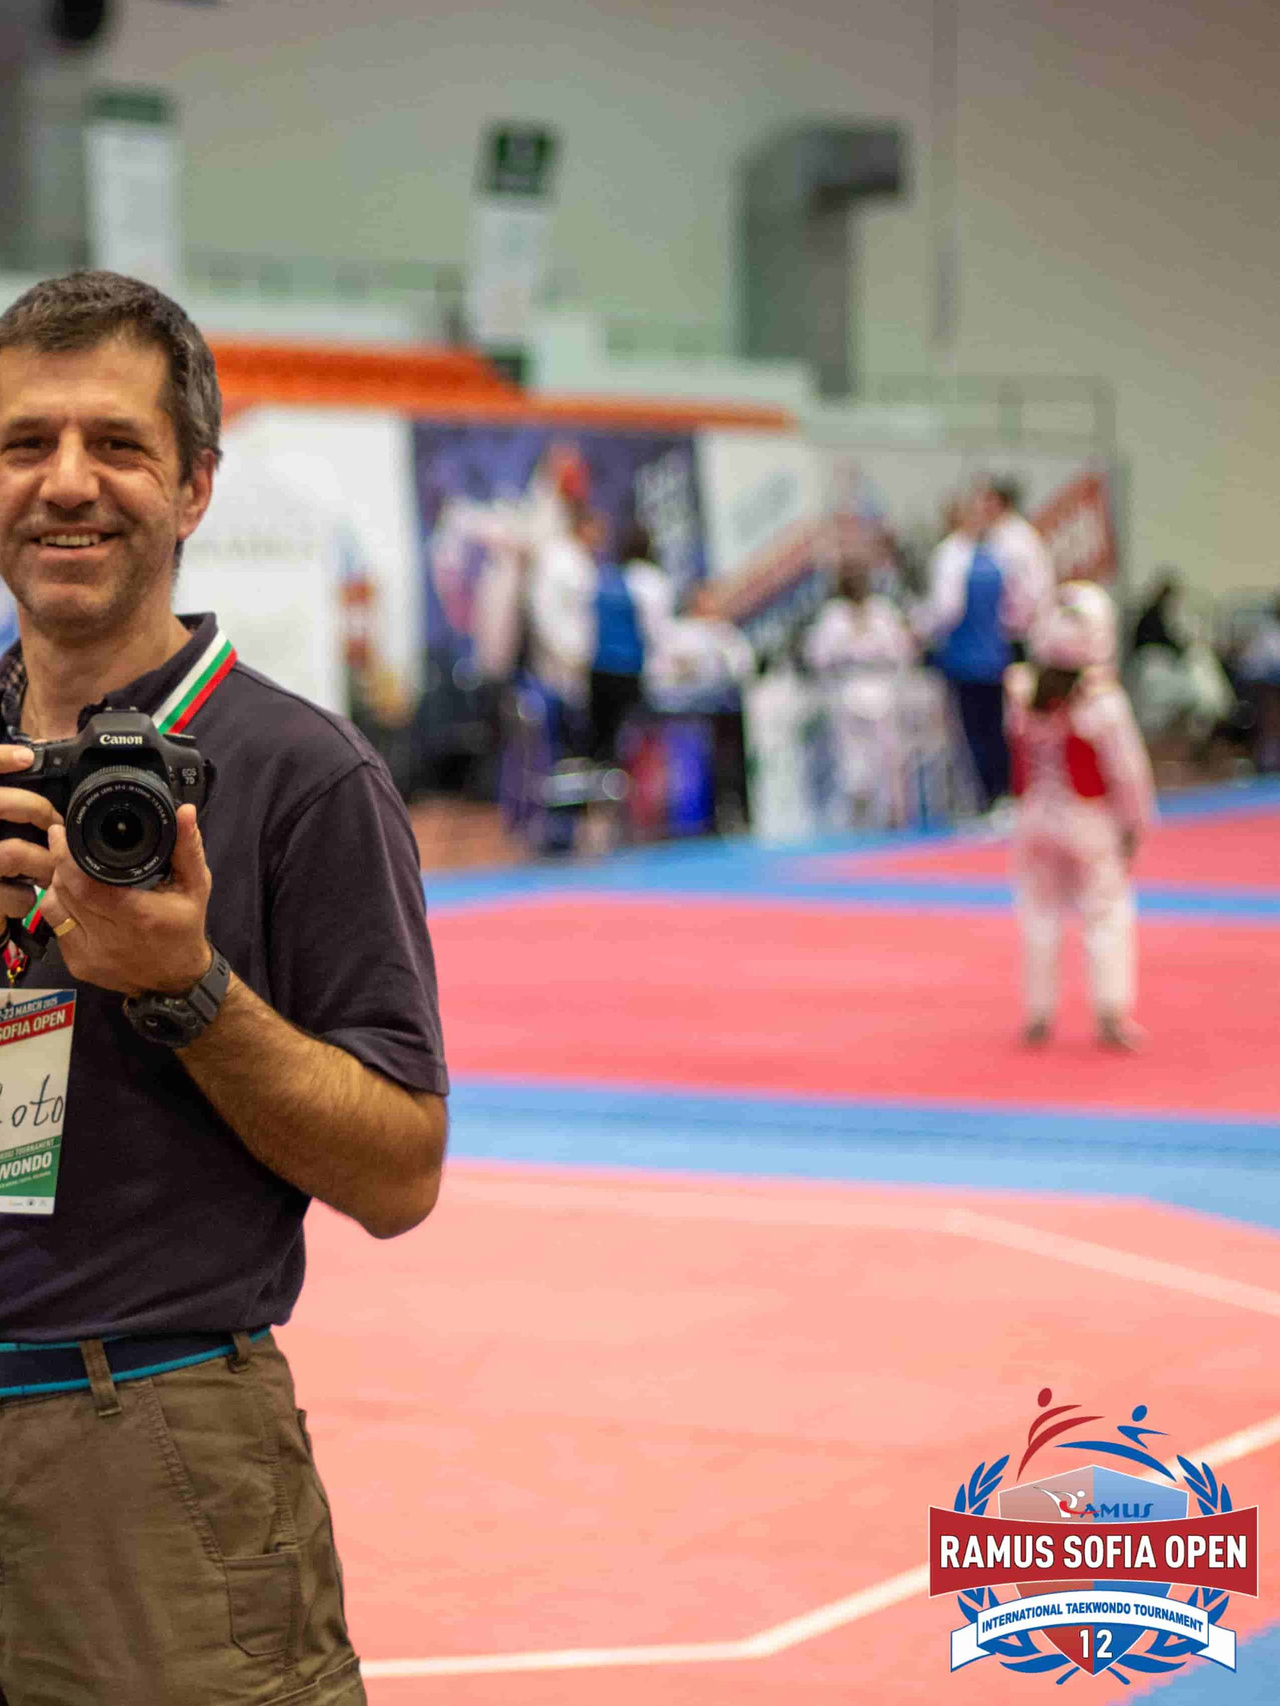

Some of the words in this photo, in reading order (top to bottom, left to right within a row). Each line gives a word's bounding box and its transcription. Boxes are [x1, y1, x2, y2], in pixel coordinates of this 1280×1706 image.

[100, 734, 143, 745] Canon
[182, 768, 197, 778] EOS
[185, 777, 195, 785] 7D
[15, 999, 43, 1017] MARCH
[33, 1009, 66, 1032] OPEN
